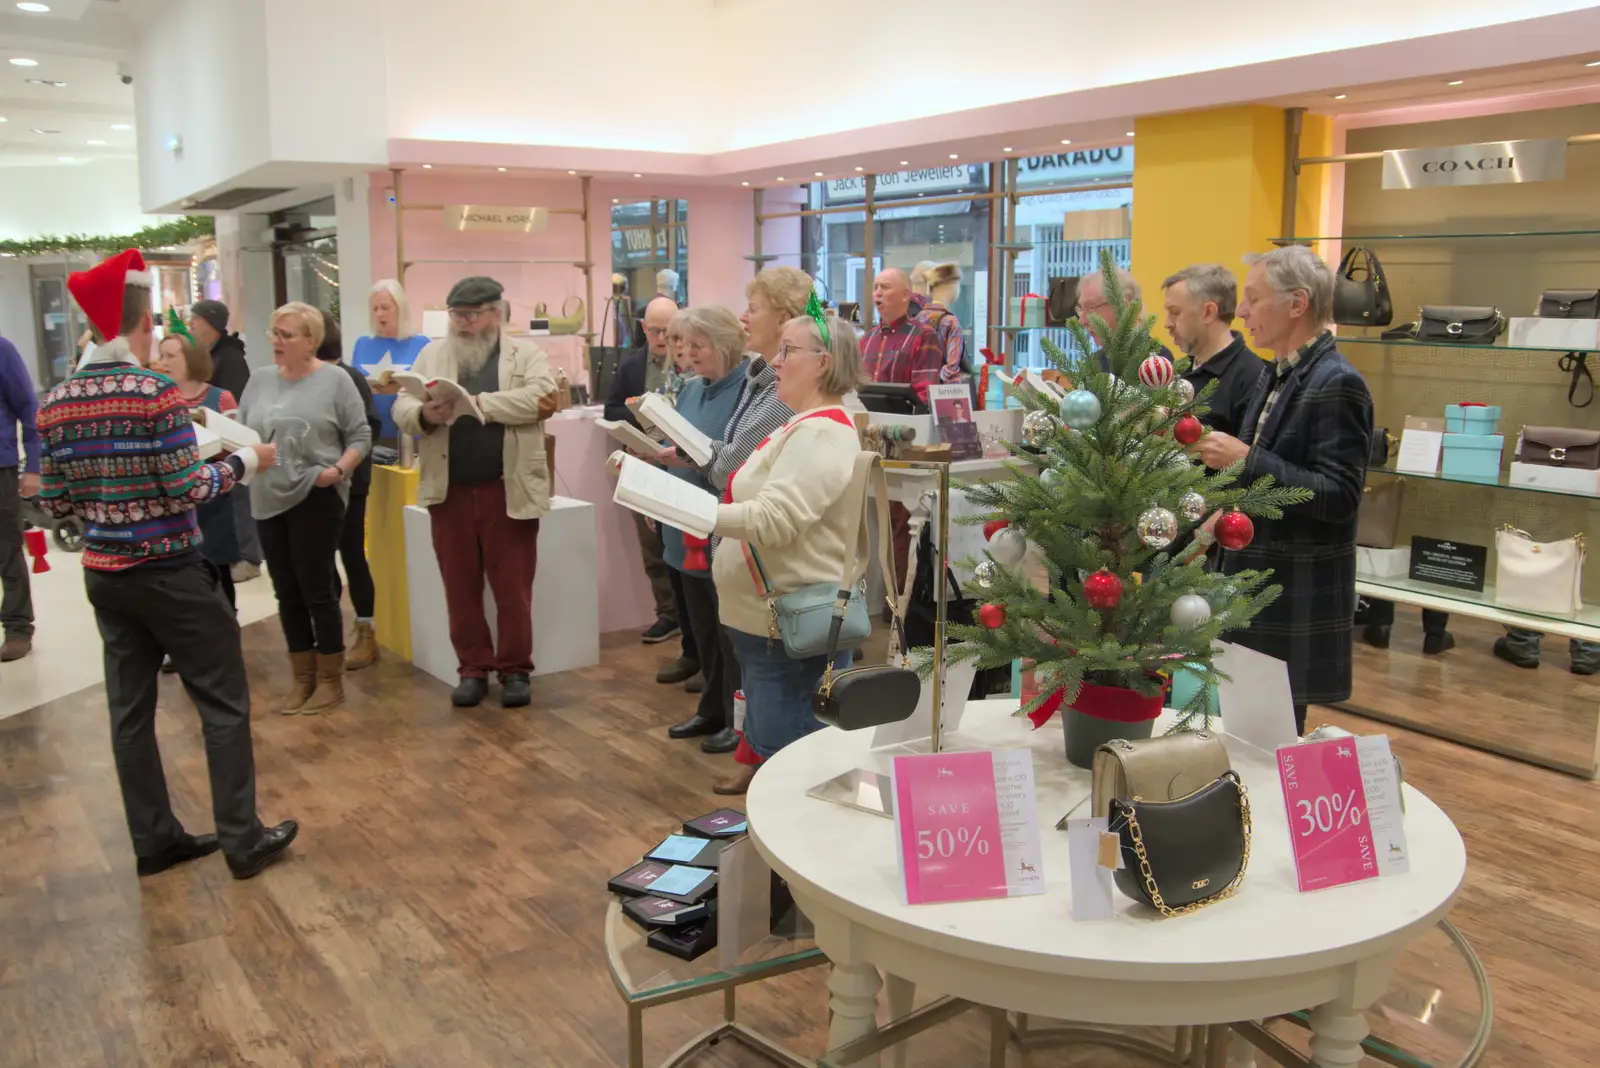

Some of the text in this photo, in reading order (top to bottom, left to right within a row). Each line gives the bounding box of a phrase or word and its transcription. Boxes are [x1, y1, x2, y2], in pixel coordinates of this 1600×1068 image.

[904, 164, 963, 183] Jewellers
[1422, 157, 1515, 173] COACH
[1283, 754, 1298, 790] SAVE
[928, 802, 971, 816] SAVE
[1295, 789, 1361, 837] 30%
[916, 824, 990, 860] 50%
[1358, 835, 1373, 871] SAVE
